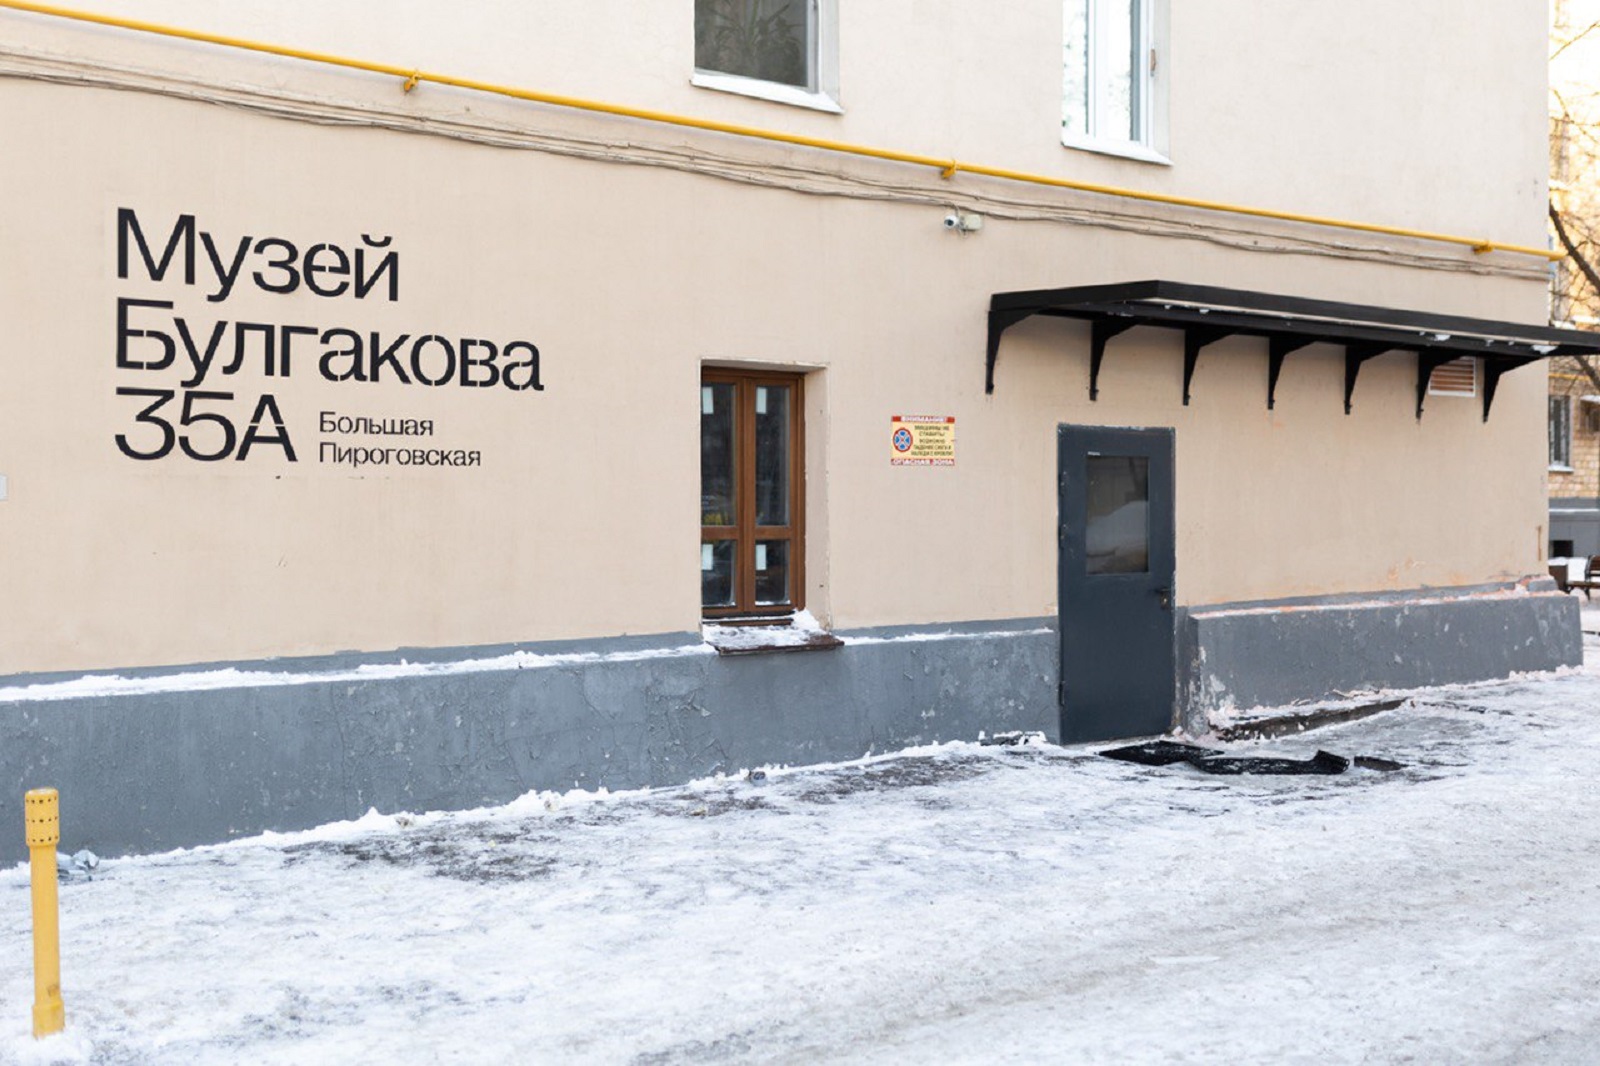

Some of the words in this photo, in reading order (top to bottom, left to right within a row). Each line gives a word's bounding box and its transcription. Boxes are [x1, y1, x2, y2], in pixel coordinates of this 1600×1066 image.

[117, 207, 399, 302] Музей
[116, 296, 545, 392] Булгакова
[319, 411, 434, 436] Большая
[319, 441, 481, 468] Пироговская
